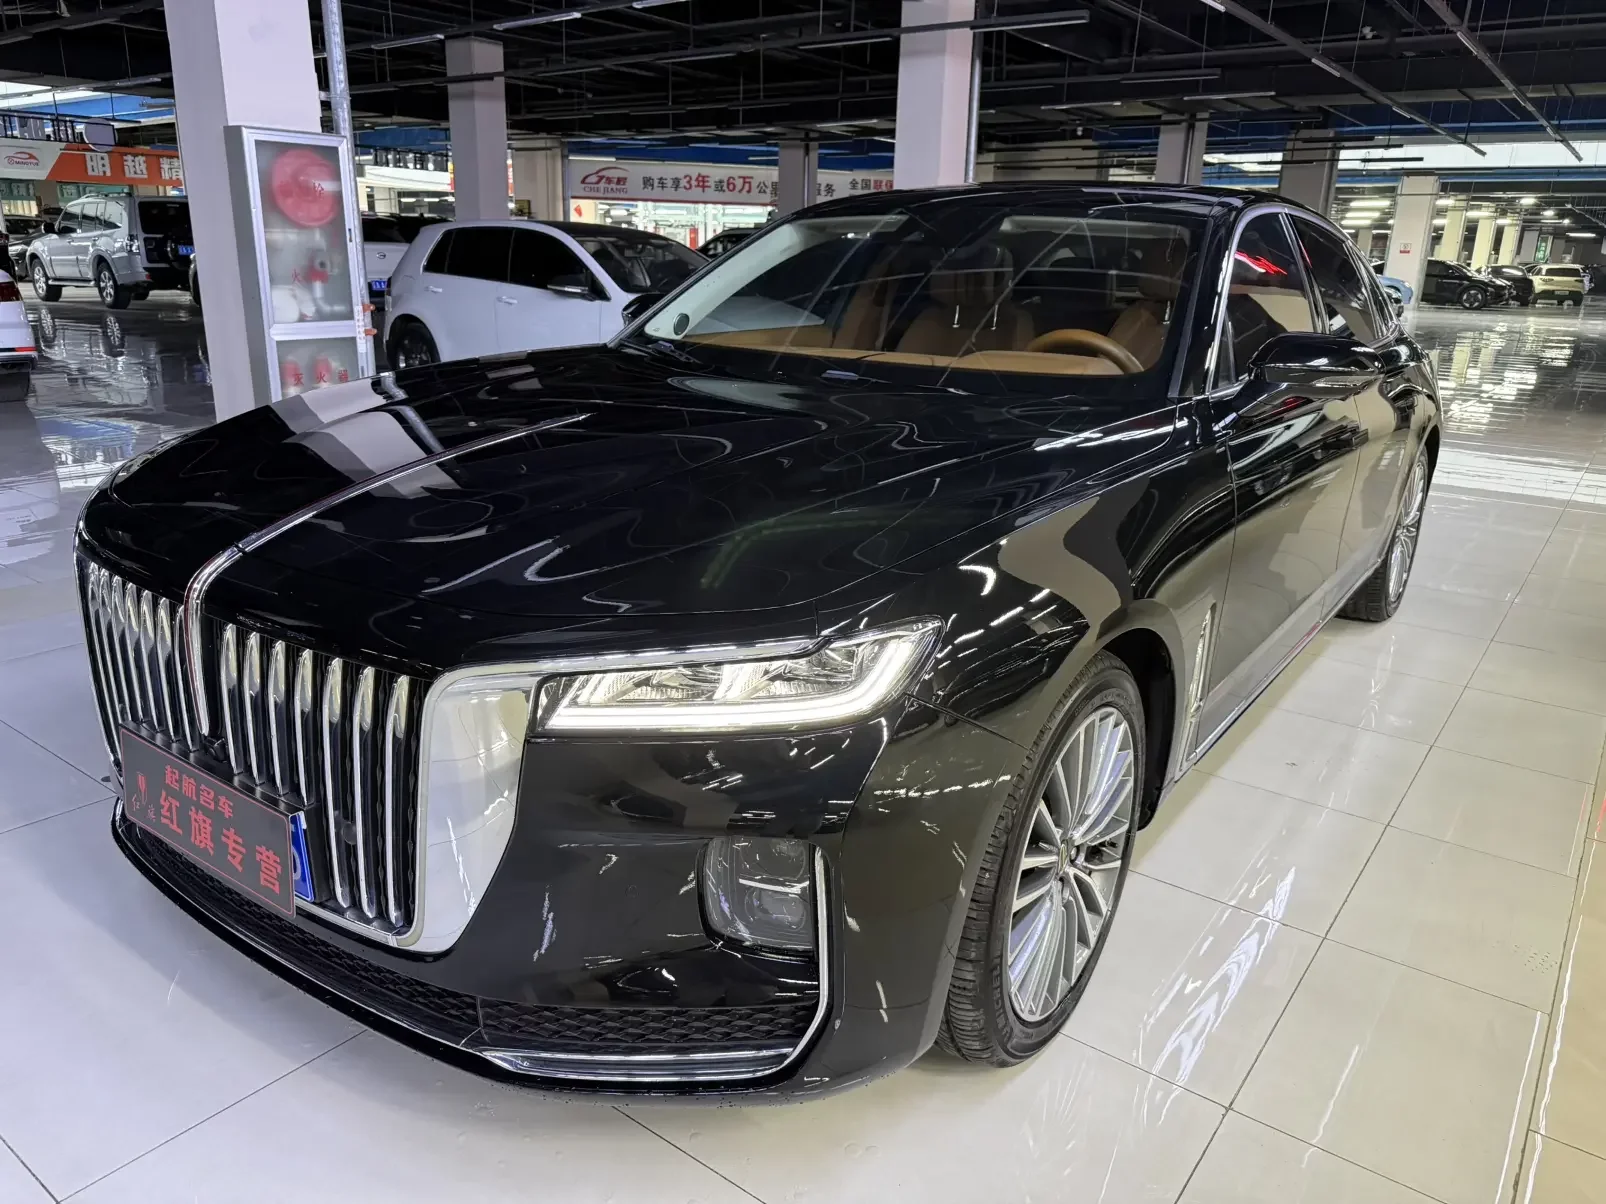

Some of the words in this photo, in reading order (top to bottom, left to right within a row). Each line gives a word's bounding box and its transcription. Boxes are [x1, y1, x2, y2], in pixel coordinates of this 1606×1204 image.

[583, 185, 600, 193] CHE
[602, 186, 628, 195] JIANG
[164, 764, 234, 819] 起航名车
[159, 788, 282, 895] 红旗专营
